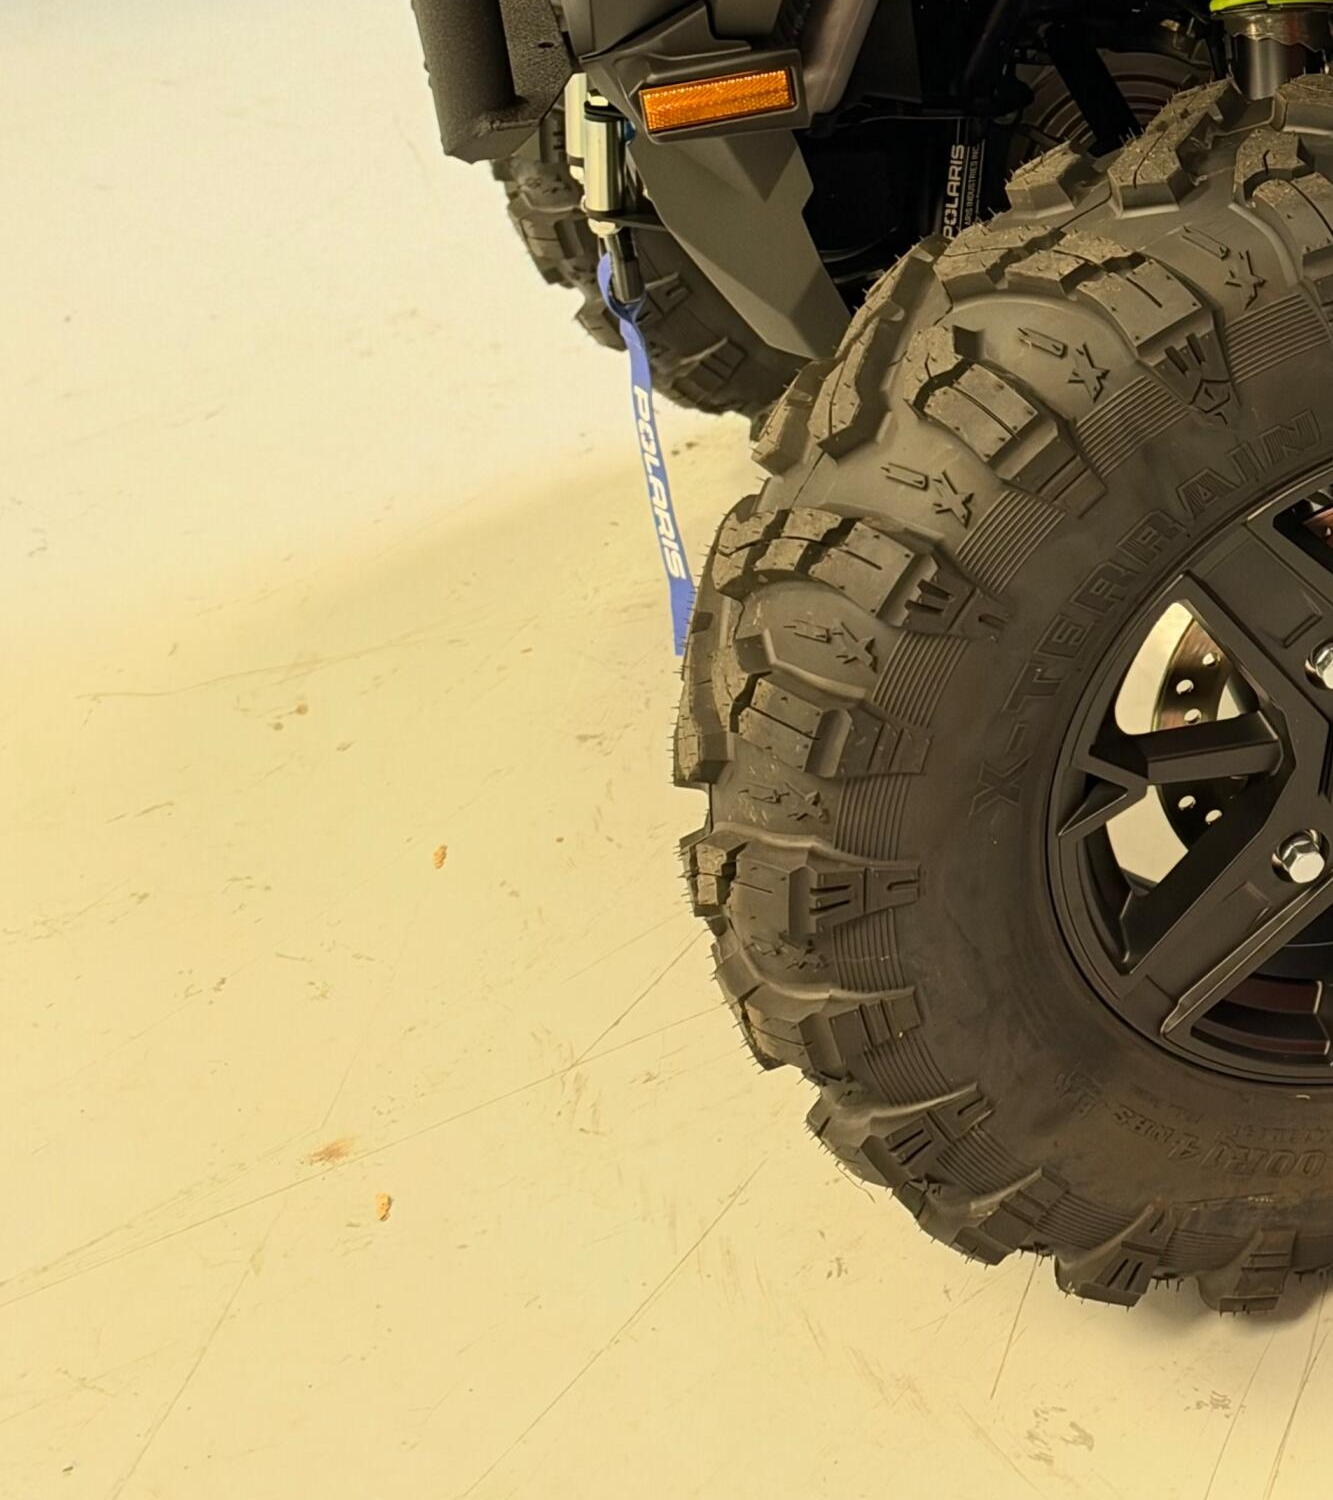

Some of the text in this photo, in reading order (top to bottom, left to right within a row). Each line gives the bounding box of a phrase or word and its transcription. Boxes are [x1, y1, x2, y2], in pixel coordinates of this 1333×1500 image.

[943, 144, 965, 242] POLARIS
[634, 385, 687, 580] POLARIS
[969, 410, 1321, 817] X-TERRAIN
